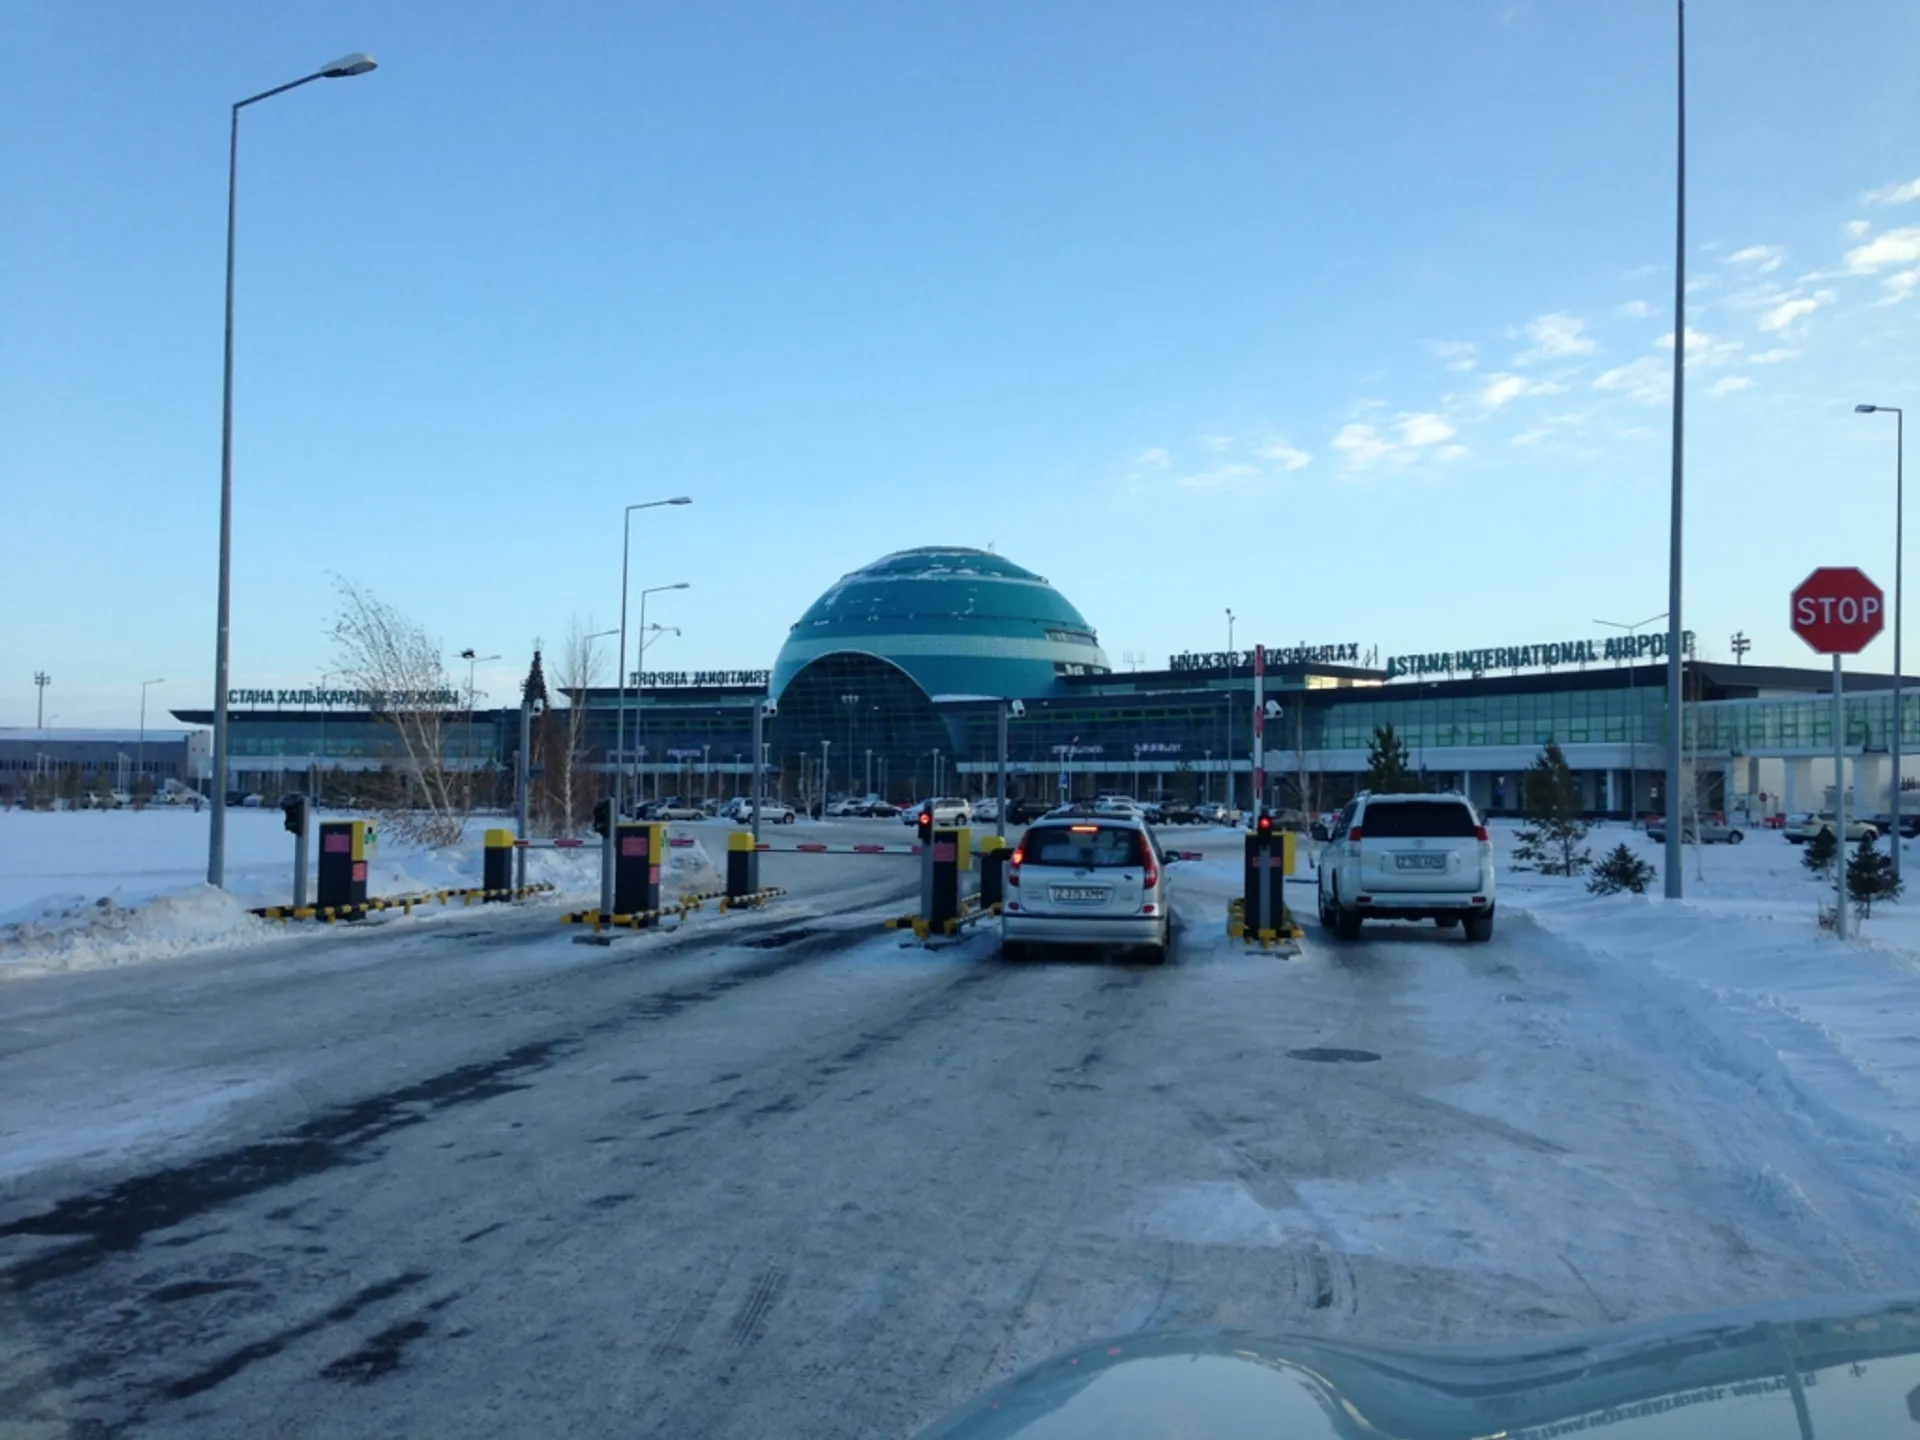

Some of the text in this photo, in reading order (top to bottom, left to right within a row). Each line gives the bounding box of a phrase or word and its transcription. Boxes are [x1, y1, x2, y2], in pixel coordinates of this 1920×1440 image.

[1797, 596, 1879, 625] STOP
[1387, 652, 1451, 680] ASTANA
[1455, 640, 1598, 672] INTERNATIONAL
[227, 688, 275, 704] СТАНА
